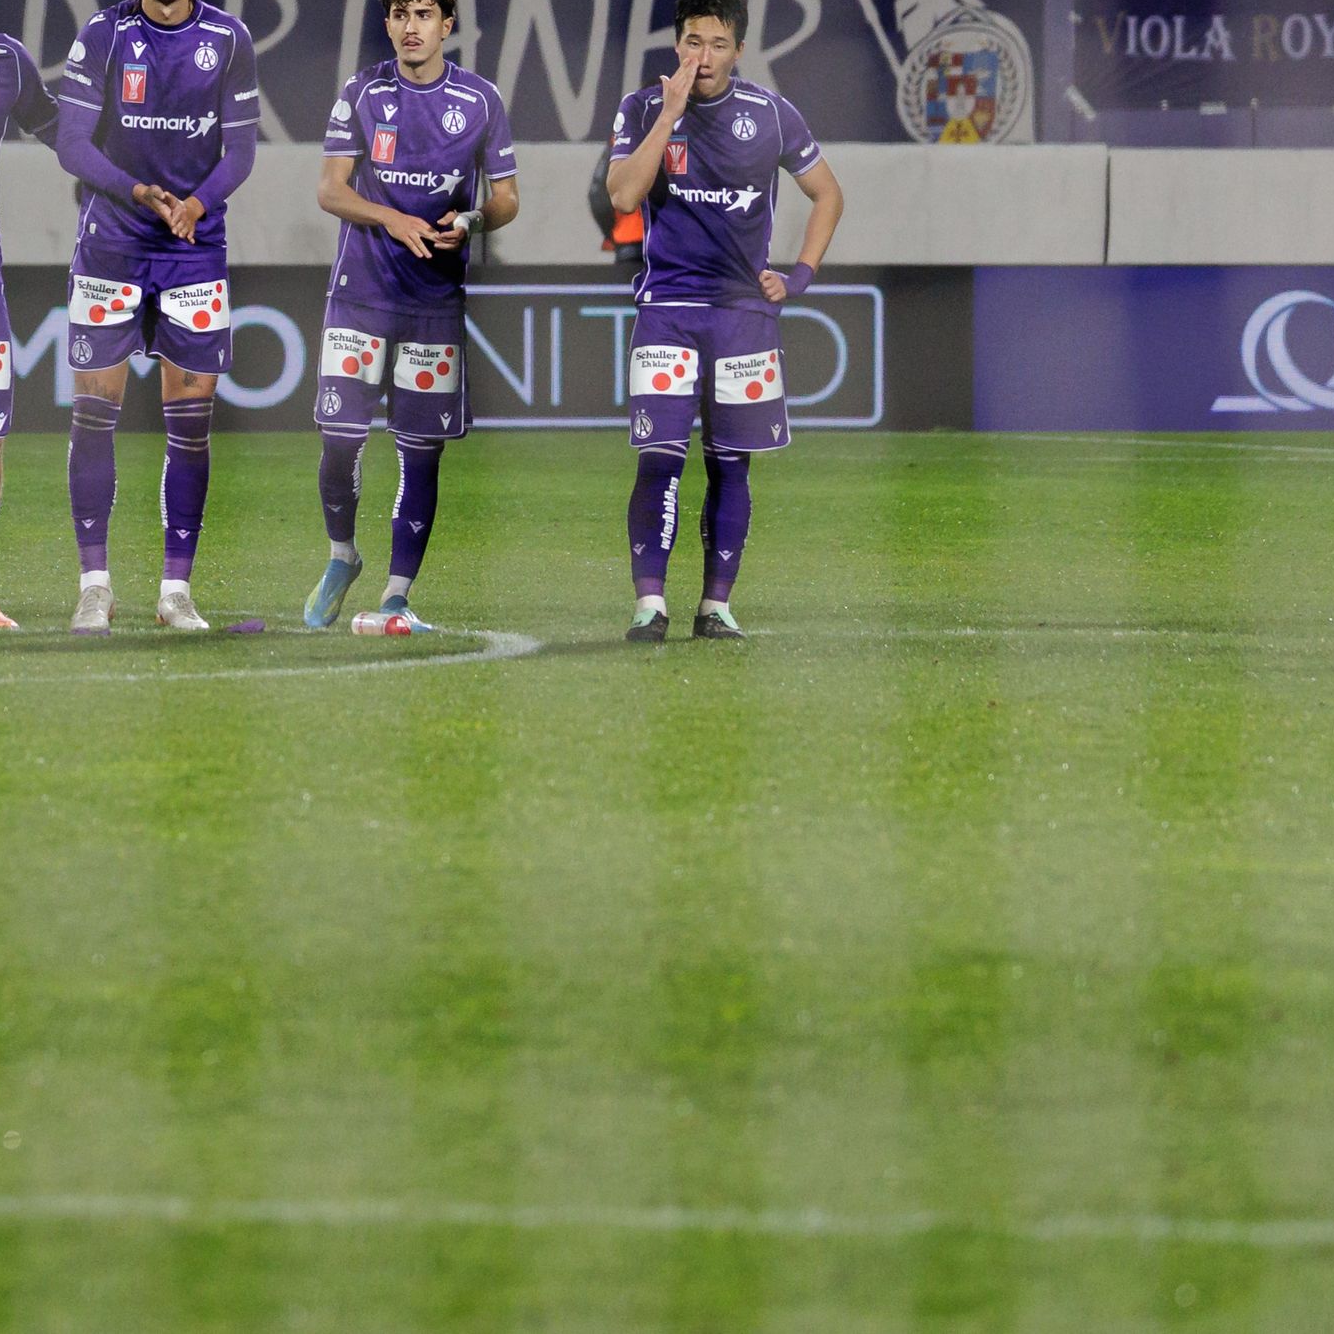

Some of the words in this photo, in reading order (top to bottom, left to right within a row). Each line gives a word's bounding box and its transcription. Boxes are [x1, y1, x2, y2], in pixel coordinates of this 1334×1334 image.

[1097, 12, 1236, 61] VIOLA
[121, 115, 195, 131] aramark
[374, 168, 437, 187] ramark
[77, 280, 117, 295] Schuller
[169, 289, 213, 300] Schuller
[328, 332, 367, 347] Schuller
[636, 350, 678, 360] Schuller
[724, 359, 766, 370] Schuller
